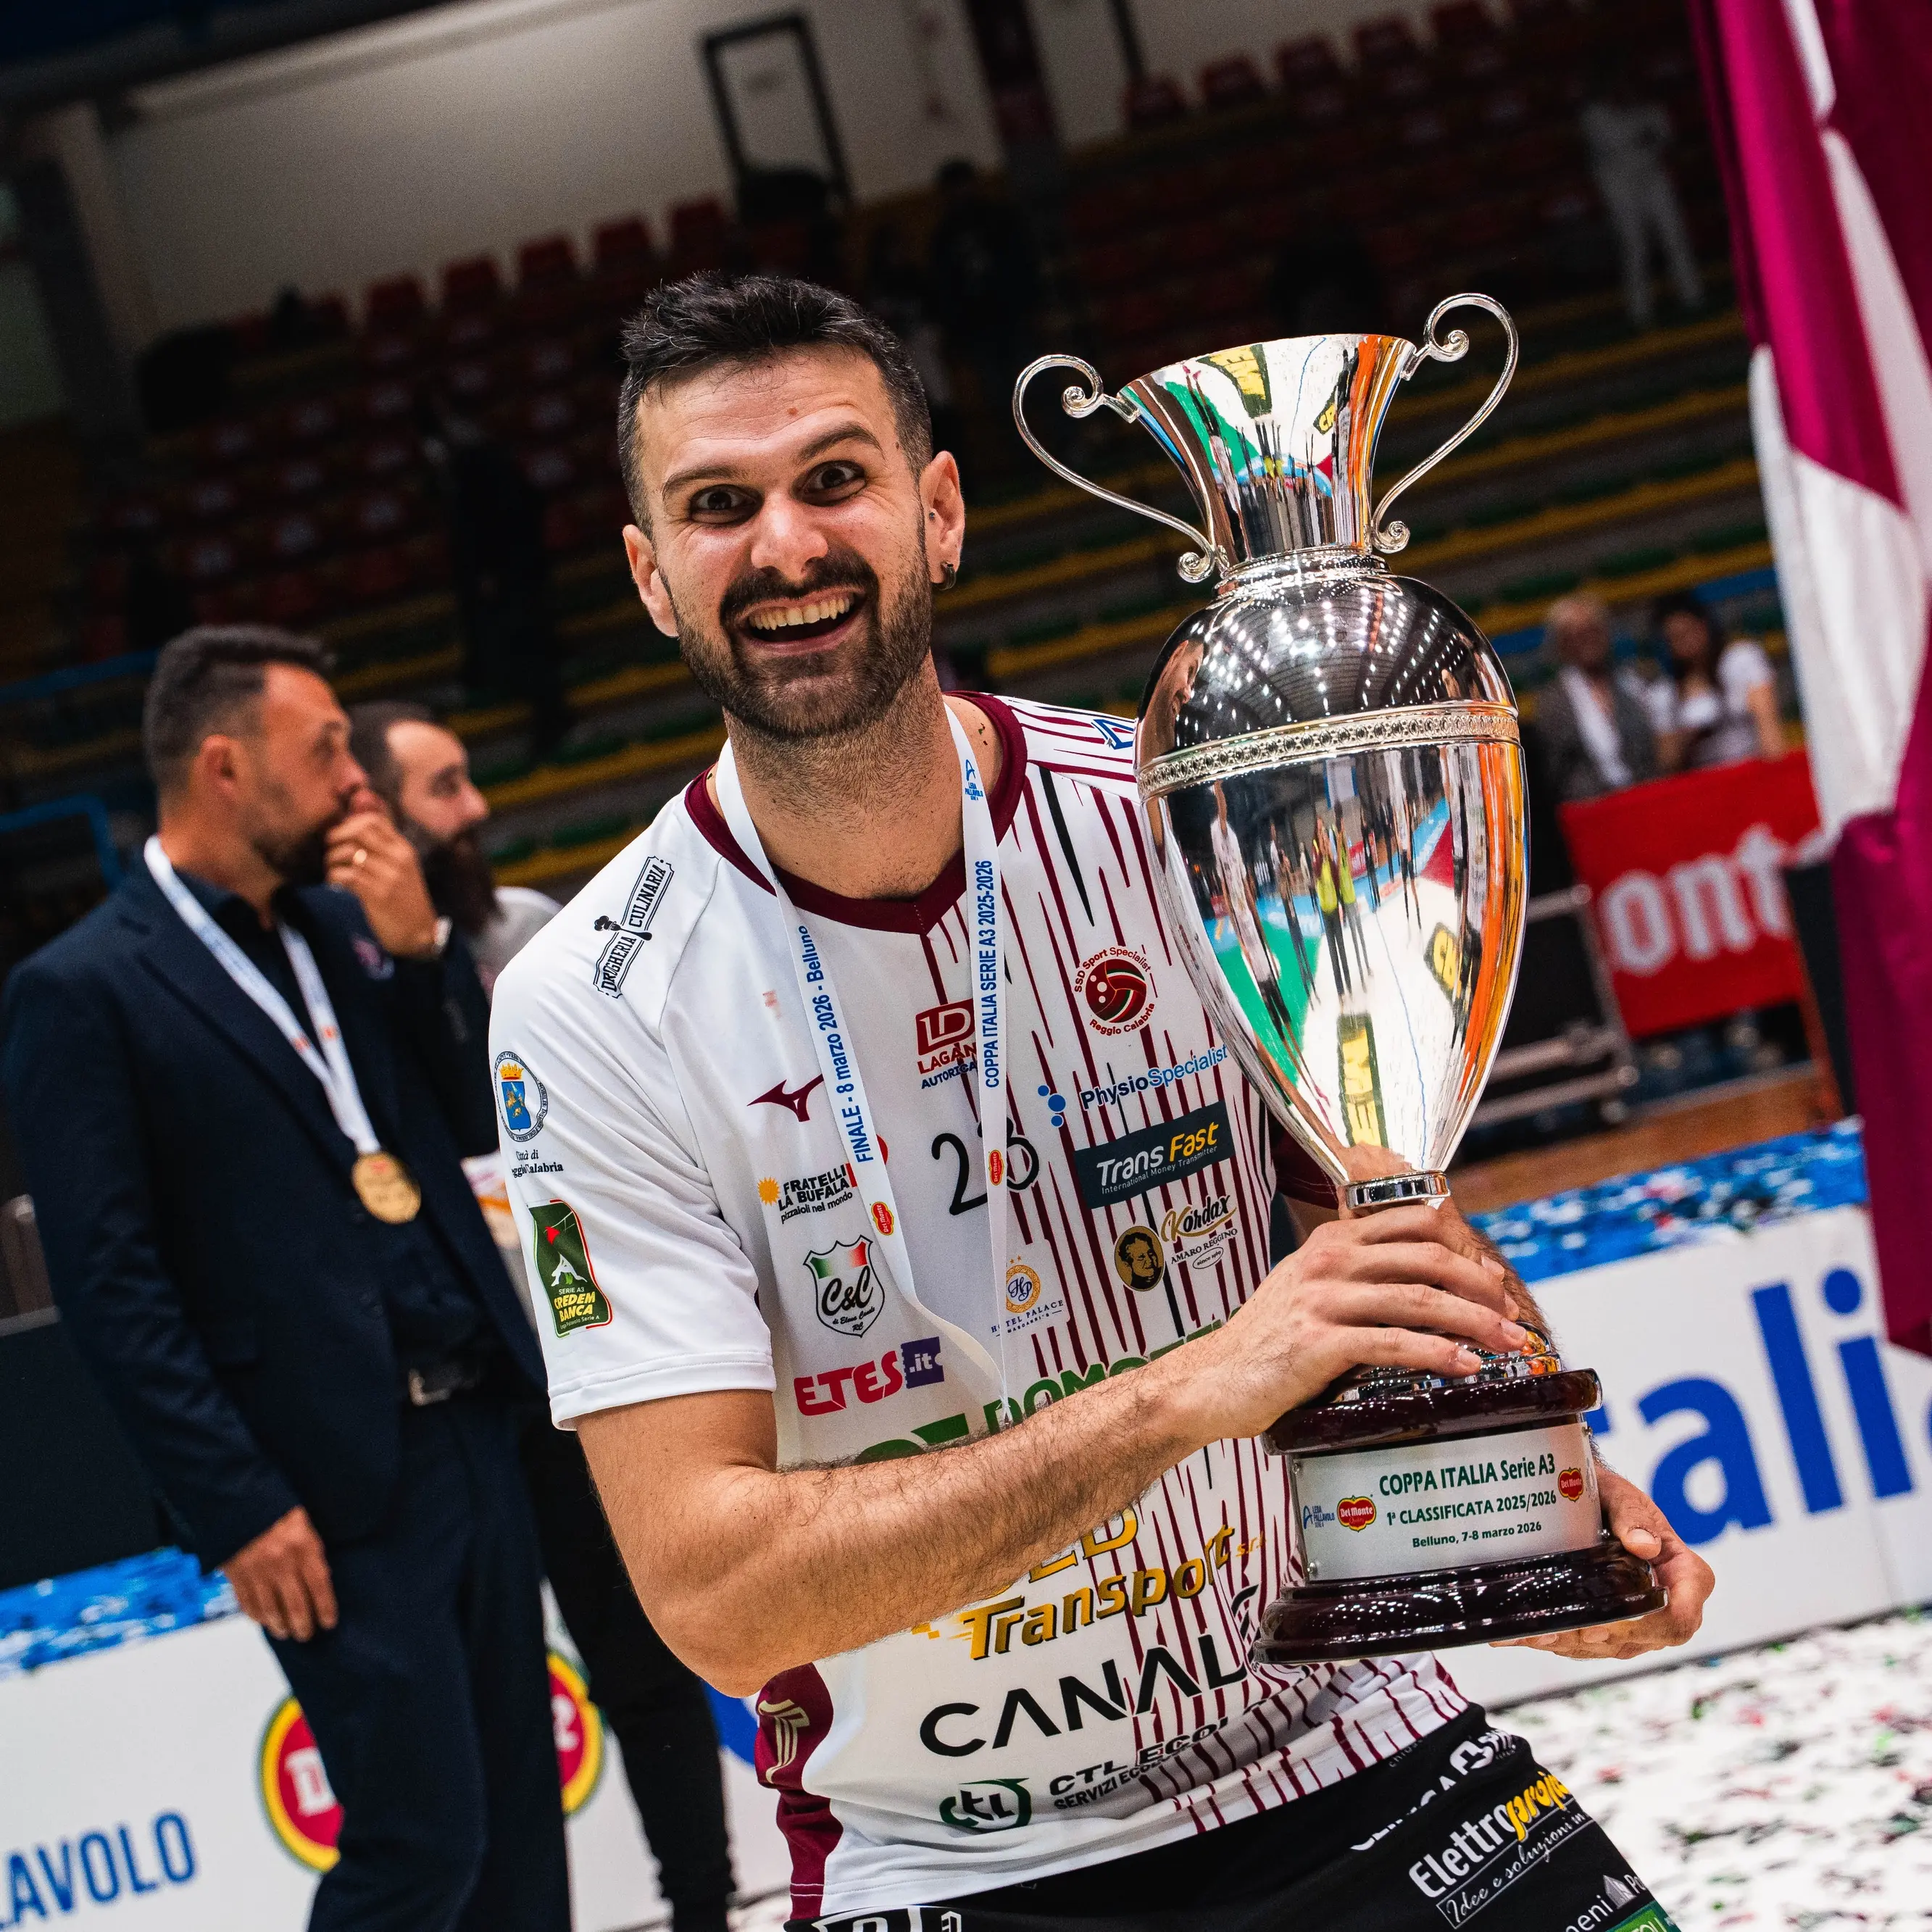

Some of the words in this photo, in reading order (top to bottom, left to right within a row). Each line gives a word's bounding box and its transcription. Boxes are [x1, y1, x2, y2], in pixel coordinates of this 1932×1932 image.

[629, 865, 666, 928] CULINARIA
[975, 860, 996, 925] 2025-2026
[798, 925, 824, 983] Belluno
[978, 928, 996, 946] A3
[979, 950, 996, 991] SERIE
[1074, 970, 1085, 993] SSD
[1082, 949, 1108, 970] Sport
[1109, 947, 1151, 973] Specialist
[812, 994, 838, 1030] 2026
[981, 994, 998, 1037] ITALIA
[1090, 1019, 1121, 1036] Reggio
[1123, 1003, 1154, 1033] Calabria
[827, 1033, 852, 1080] marzo
[917, 1042, 977, 1074] LAGAN
[921, 1062, 978, 1089] AUTORICA
[983, 1040, 999, 1088] COPPA
[1080, 1044, 1228, 1109] PhysioSpecialist
[836, 1083, 854, 1094] 8
[531, 1149, 539, 1159] di
[842, 1106, 873, 1163] FINALE
[1096, 1146, 1164, 1186] Trans
[1170, 1122, 1219, 1162] Fast
[783, 1165, 847, 1195] FRATELLI
[1102, 1172, 1149, 1194] International
[1151, 1164, 1176, 1177] Money
[1178, 1146, 1217, 1167] Transmitter
[778, 1195, 794, 1211] LA
[796, 1178, 849, 1203] BUFALA
[780, 1204, 811, 1225] pizzaioli
[812, 1202, 825, 1212] nel
[828, 1191, 853, 1209] mondo
[1161, 1195, 1236, 1242] Kordax
[1171, 1246, 1202, 1264] AMARO
[1203, 1228, 1238, 1250] REGGINO
[554, 1291, 596, 1309] CREDEM
[821, 1265, 873, 1316] C&C
[1026, 1300, 1064, 1318] PALACE
[559, 1304, 593, 1323] BANCA
[1591, 1268, 1932, 1549] ali
[1379, 1470, 1438, 1496] COPPA
[1440, 1462, 1498, 1489] ITALIA
[1500, 1457, 1536, 1481] Serie
[1538, 1453, 1556, 1475] A3
[1340, 1508, 1350, 1517] Del
[1350, 1506, 1373, 1516] Monte
[1399, 1499, 1494, 1525] CLASSIFICATA
[1496, 1490, 1557, 1512] 2025/2026
[1412, 1536, 1459, 1548] Belluno,
[1461, 1531, 1479, 1542] 7-8
[1482, 1526, 1515, 1539] marzo
[1517, 1521, 1542, 1534] 2026
[960, 1524, 1235, 1661] Transport
[1049, 1760, 1128, 1796] CTL
[1137, 1717, 1229, 1766] ECO
[1054, 1776, 1118, 1810] SERVIZI
[0, 1813, 196, 1928] AVOLO
[1446, 1887, 1488, 1924] Idee
[1492, 1877, 1502, 1887] e
[1505, 1817, 1573, 1878] soluzioni
